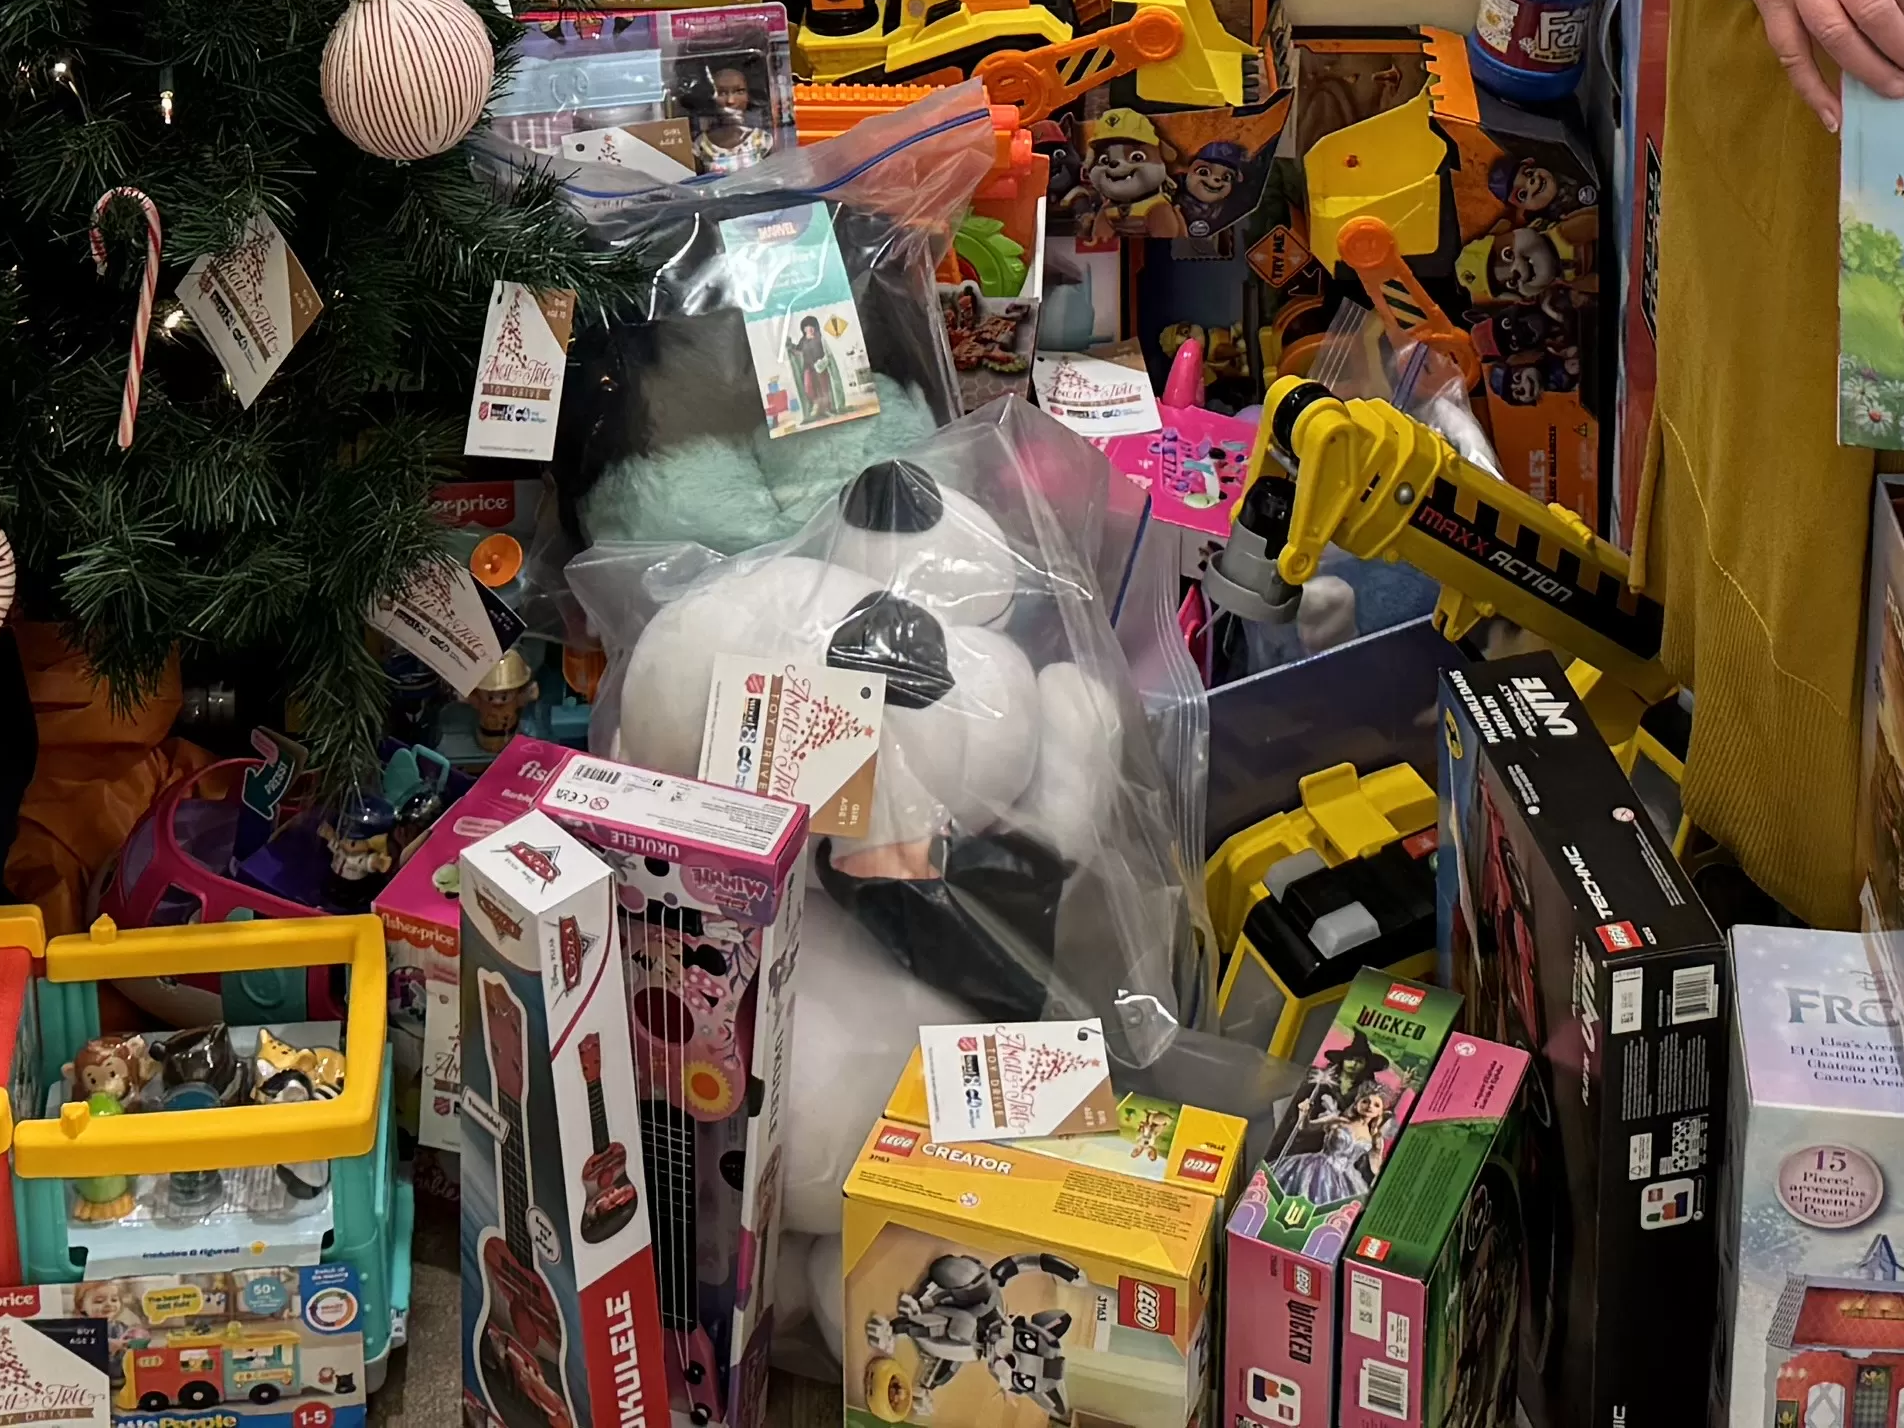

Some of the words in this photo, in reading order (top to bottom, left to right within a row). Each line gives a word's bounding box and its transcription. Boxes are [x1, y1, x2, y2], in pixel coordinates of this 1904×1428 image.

[1418, 504, 1490, 557] MAXX
[1488, 549, 1573, 603] ACTION
[610, 829, 680, 858] UKULELE
[1561, 844, 1614, 920] TECHNIC
[1387, 988, 1424, 1010] LEGO
[1356, 1003, 1428, 1043] WICKED
[880, 1132, 915, 1149] LEGO
[919, 1142, 1014, 1175] CREATOR
[1814, 1149, 1847, 1172] 15
[1135, 1282, 1161, 1329] LEGO
[1286, 1297, 1319, 1366] WICKED
[298, 1408, 328, 1426] 1-5
